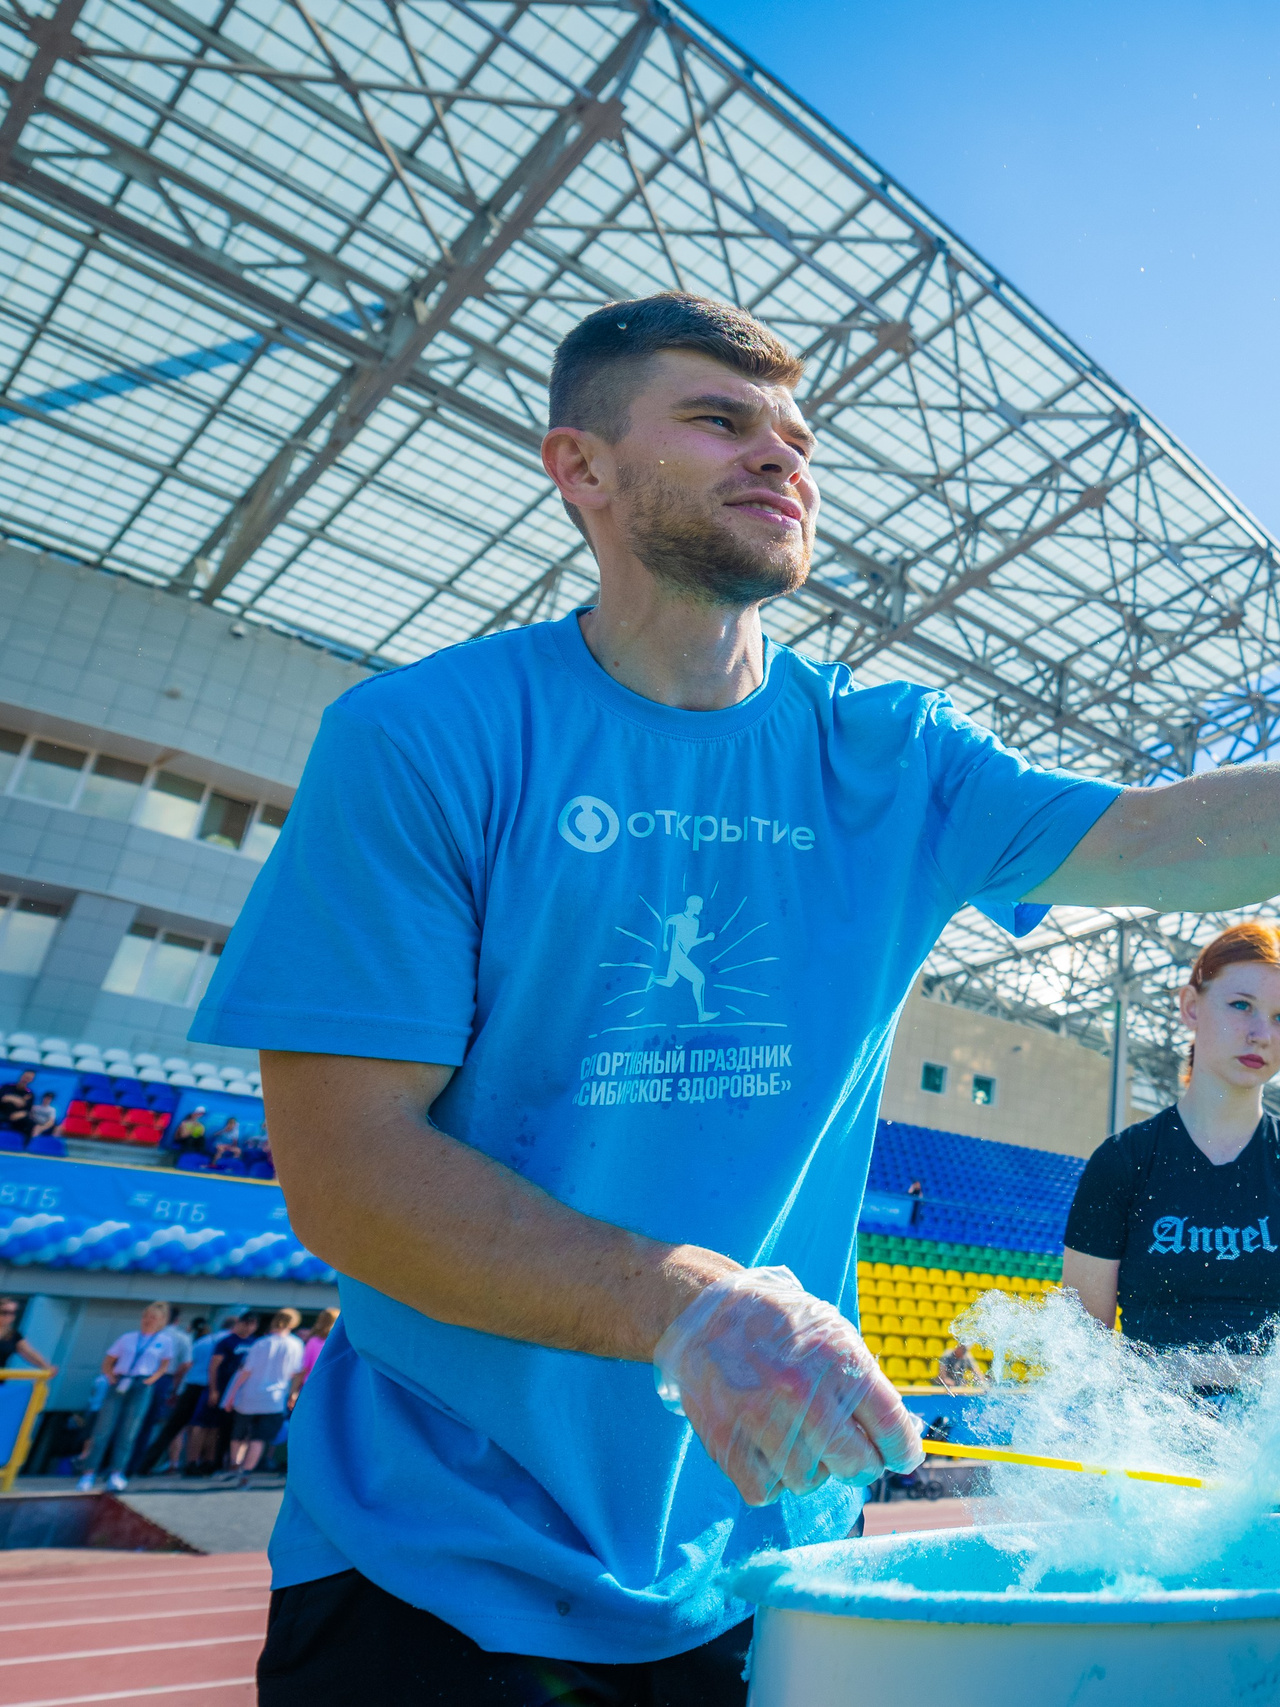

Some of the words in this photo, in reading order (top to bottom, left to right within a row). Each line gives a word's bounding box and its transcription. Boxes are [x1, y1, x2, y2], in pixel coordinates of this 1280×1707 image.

[690, 1044, 793, 1073] ПРАЗДНИК
[677, 1072, 793, 1104] ЗДОРОВЬЕ»
[1148, 1215, 1279, 1261] Angel
